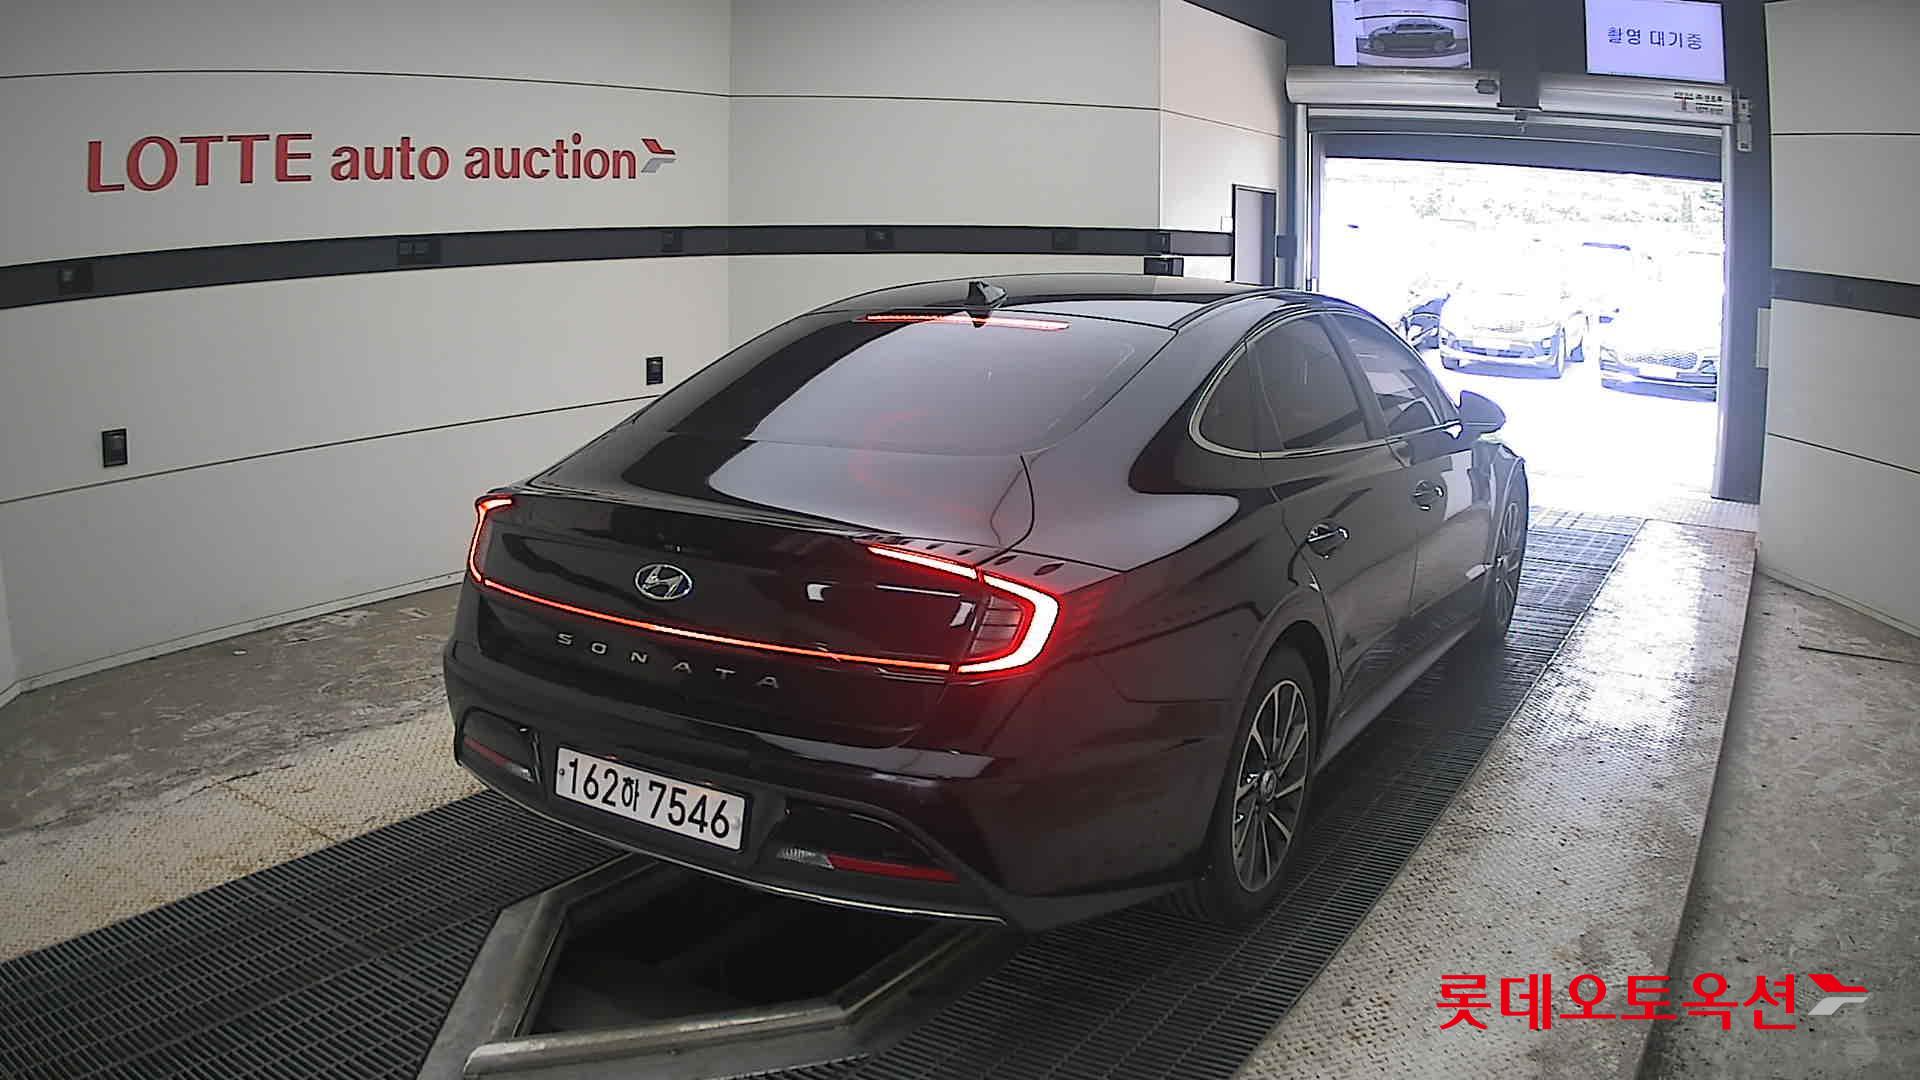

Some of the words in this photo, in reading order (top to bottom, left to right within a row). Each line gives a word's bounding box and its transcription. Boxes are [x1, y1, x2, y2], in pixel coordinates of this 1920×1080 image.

[1607, 27, 1641, 45] 촬영
[87, 133, 313, 193] LOTTE
[330, 136, 450, 181] auto
[464, 132, 637, 180] auction
[557, 632, 780, 689] SONATA
[648, 780, 731, 839] 7546
